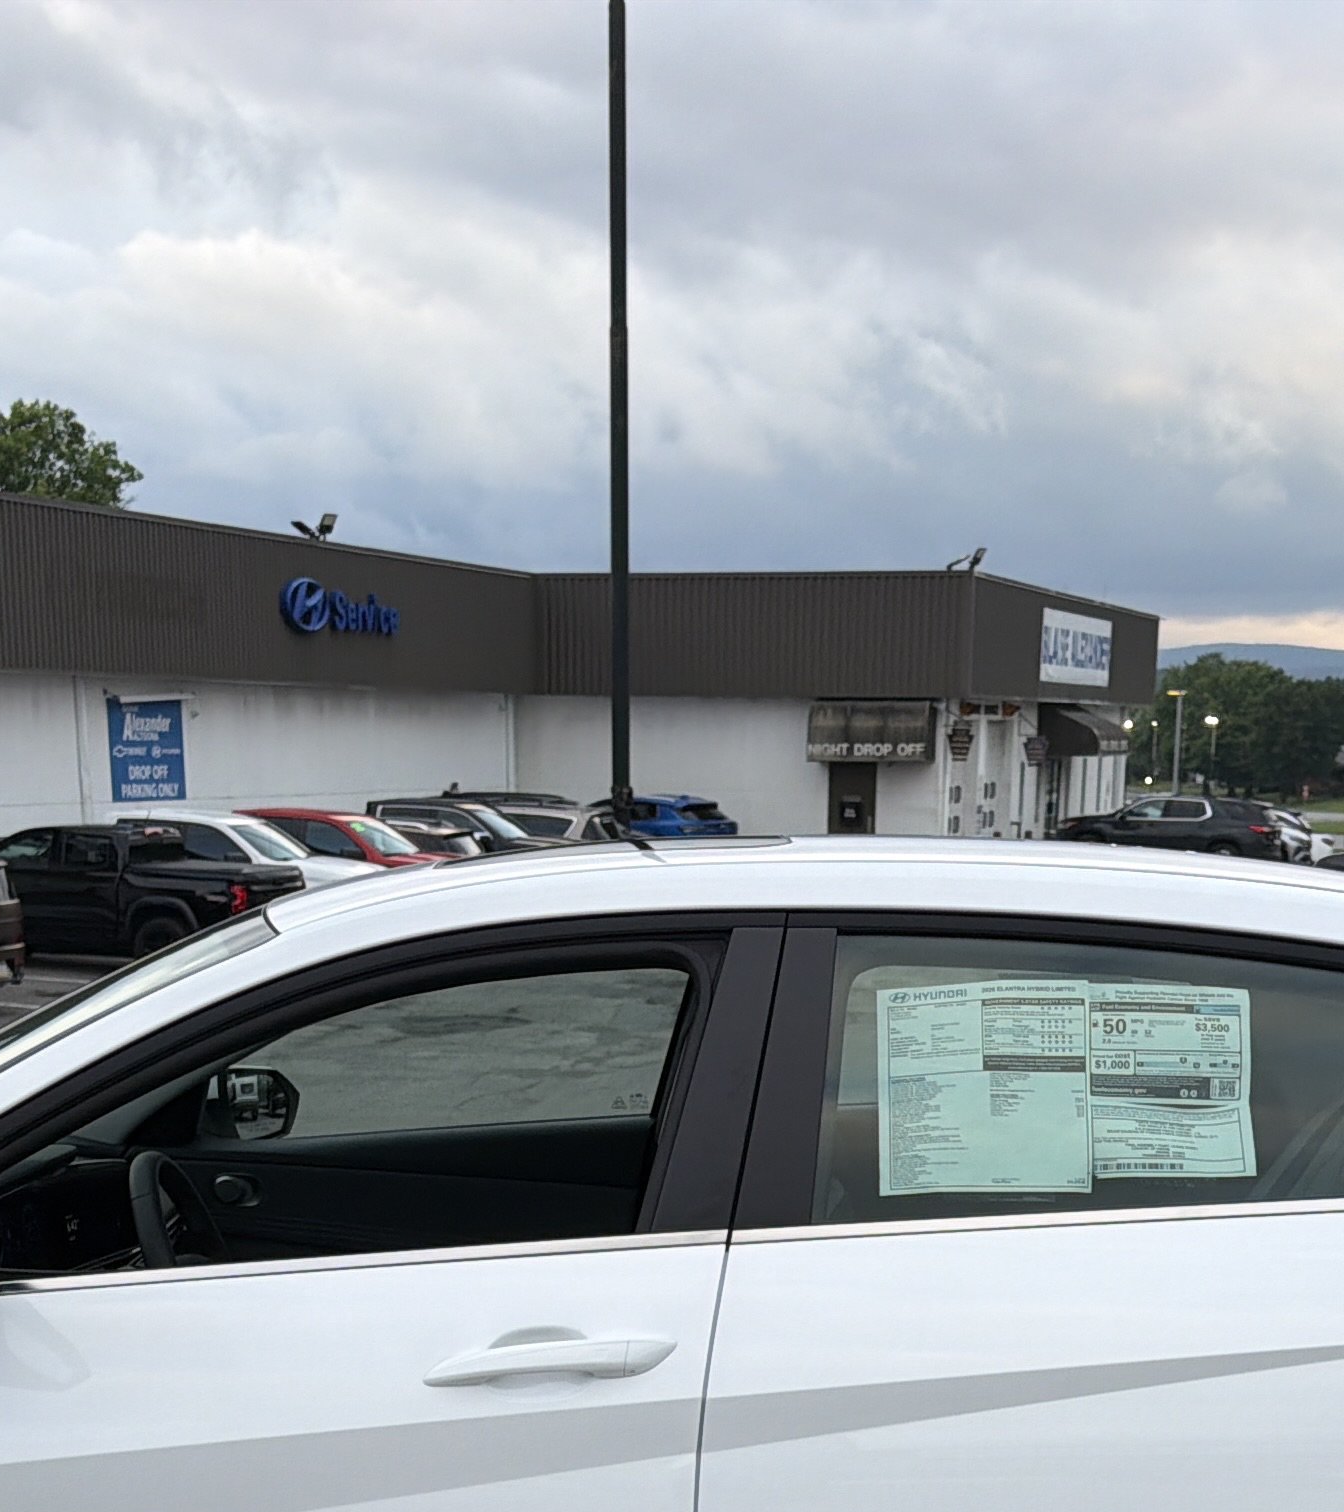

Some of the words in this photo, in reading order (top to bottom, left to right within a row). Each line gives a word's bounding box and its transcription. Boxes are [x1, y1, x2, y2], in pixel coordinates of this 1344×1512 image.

[331, 589, 399, 637] Service
[808, 743, 849, 756] NIGHT
[853, 744, 893, 757] DROP
[897, 744, 926, 757] OFF
[128, 765, 151, 780] DROP
[152, 765, 169, 780] OFF
[121, 784, 157, 798] PARKING
[158, 784, 179, 797] ONLY
[913, 988, 967, 1002] HYUNDAI
[1103, 1018, 1127, 1035] 50
[1195, 1022, 1230, 1033] $3,500
[1095, 1059, 1130, 1070] $1,000
